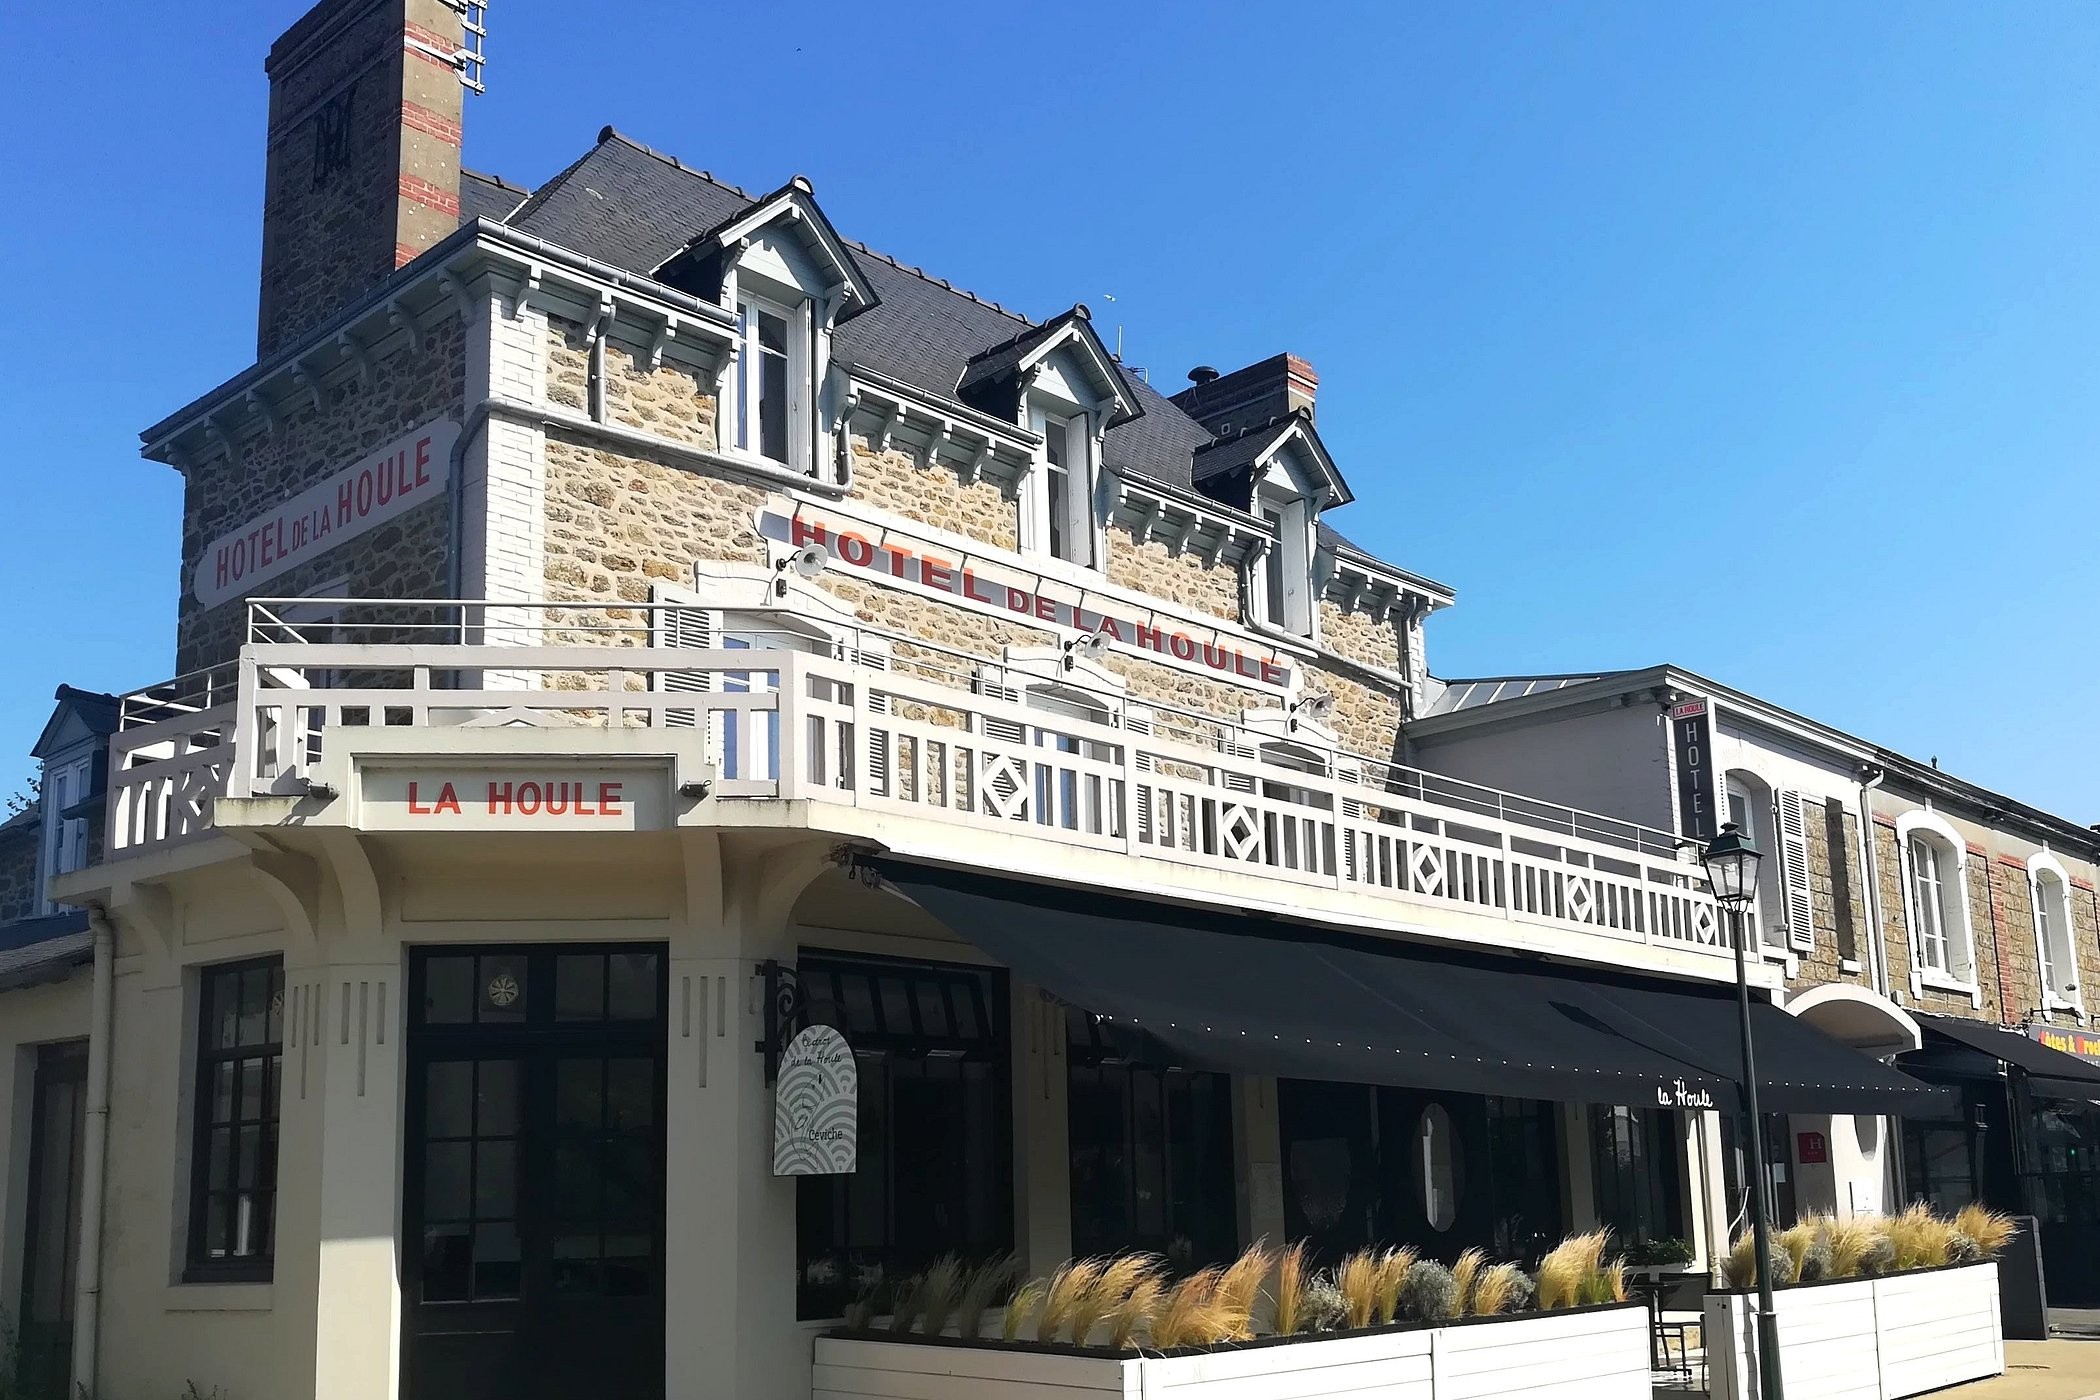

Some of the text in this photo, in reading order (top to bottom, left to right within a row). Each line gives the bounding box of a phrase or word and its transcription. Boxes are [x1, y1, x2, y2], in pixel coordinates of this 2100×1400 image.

[215, 436, 431, 590] HOTEL DE LA HOULE
[791, 515, 1283, 687] HOTEL DE LA HOULE
[409, 781, 623, 816] LA HOULE
[1685, 721, 1705, 837] HOTEL
[1657, 1079, 1714, 1108] la Houle
[808, 1127, 843, 1141] Ceviche
